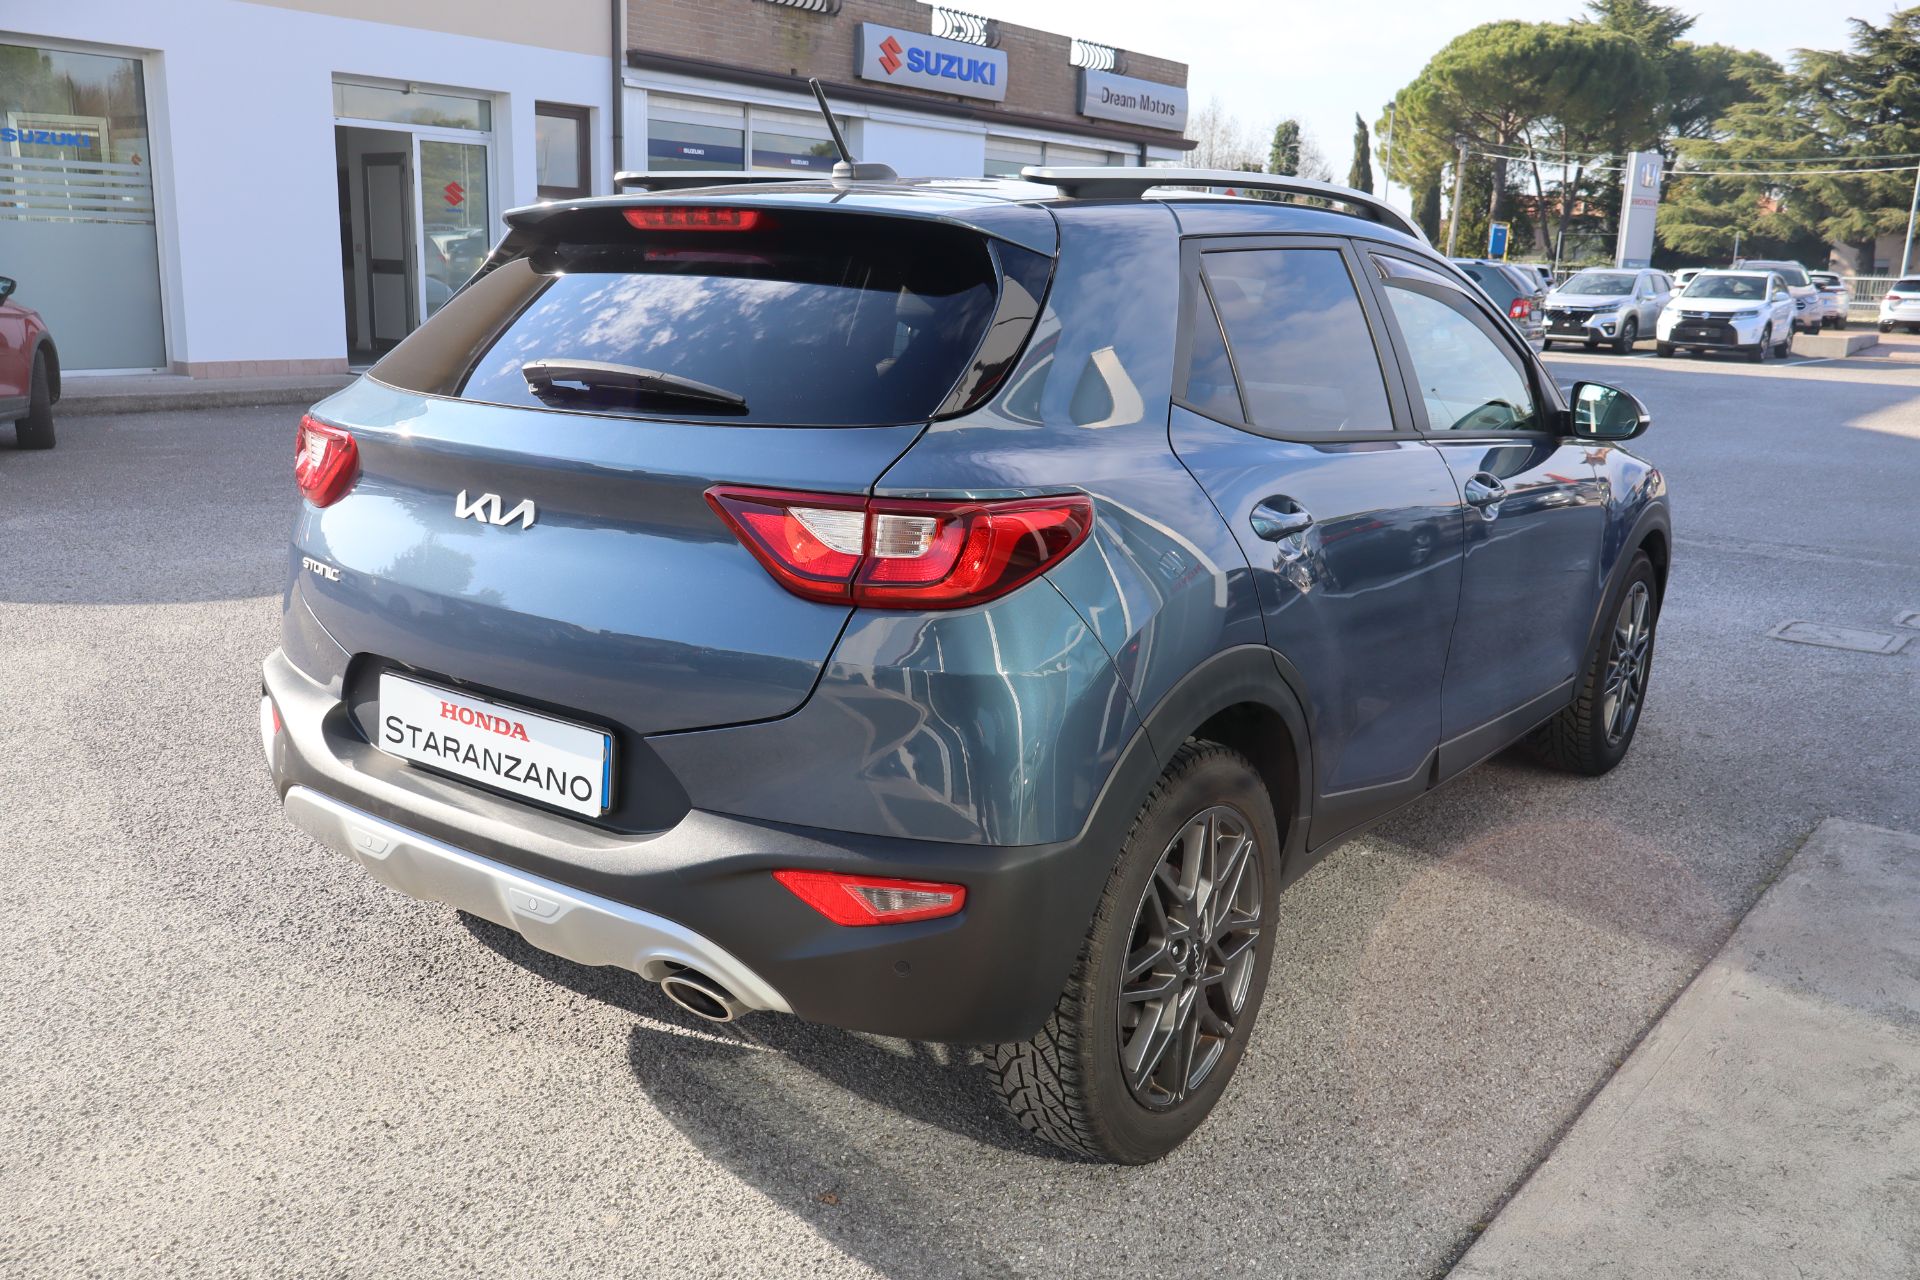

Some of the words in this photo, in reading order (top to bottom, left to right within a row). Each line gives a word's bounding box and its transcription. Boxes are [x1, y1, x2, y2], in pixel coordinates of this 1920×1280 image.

[907, 47, 996, 86] SUZUKI
[1101, 86, 1136, 110] Dream
[1140, 94, 1176, 117] Motors
[0, 127, 91, 148] SUZUKI
[683, 147, 705, 156] SUZUKI
[790, 158, 809, 166] SUZUKI
[1631, 197, 1658, 207] HONDA
[455, 489, 535, 530] KIA
[302, 556, 341, 583] STONIC
[440, 701, 530, 743] HONDA
[385, 715, 593, 802] STARANZANO
